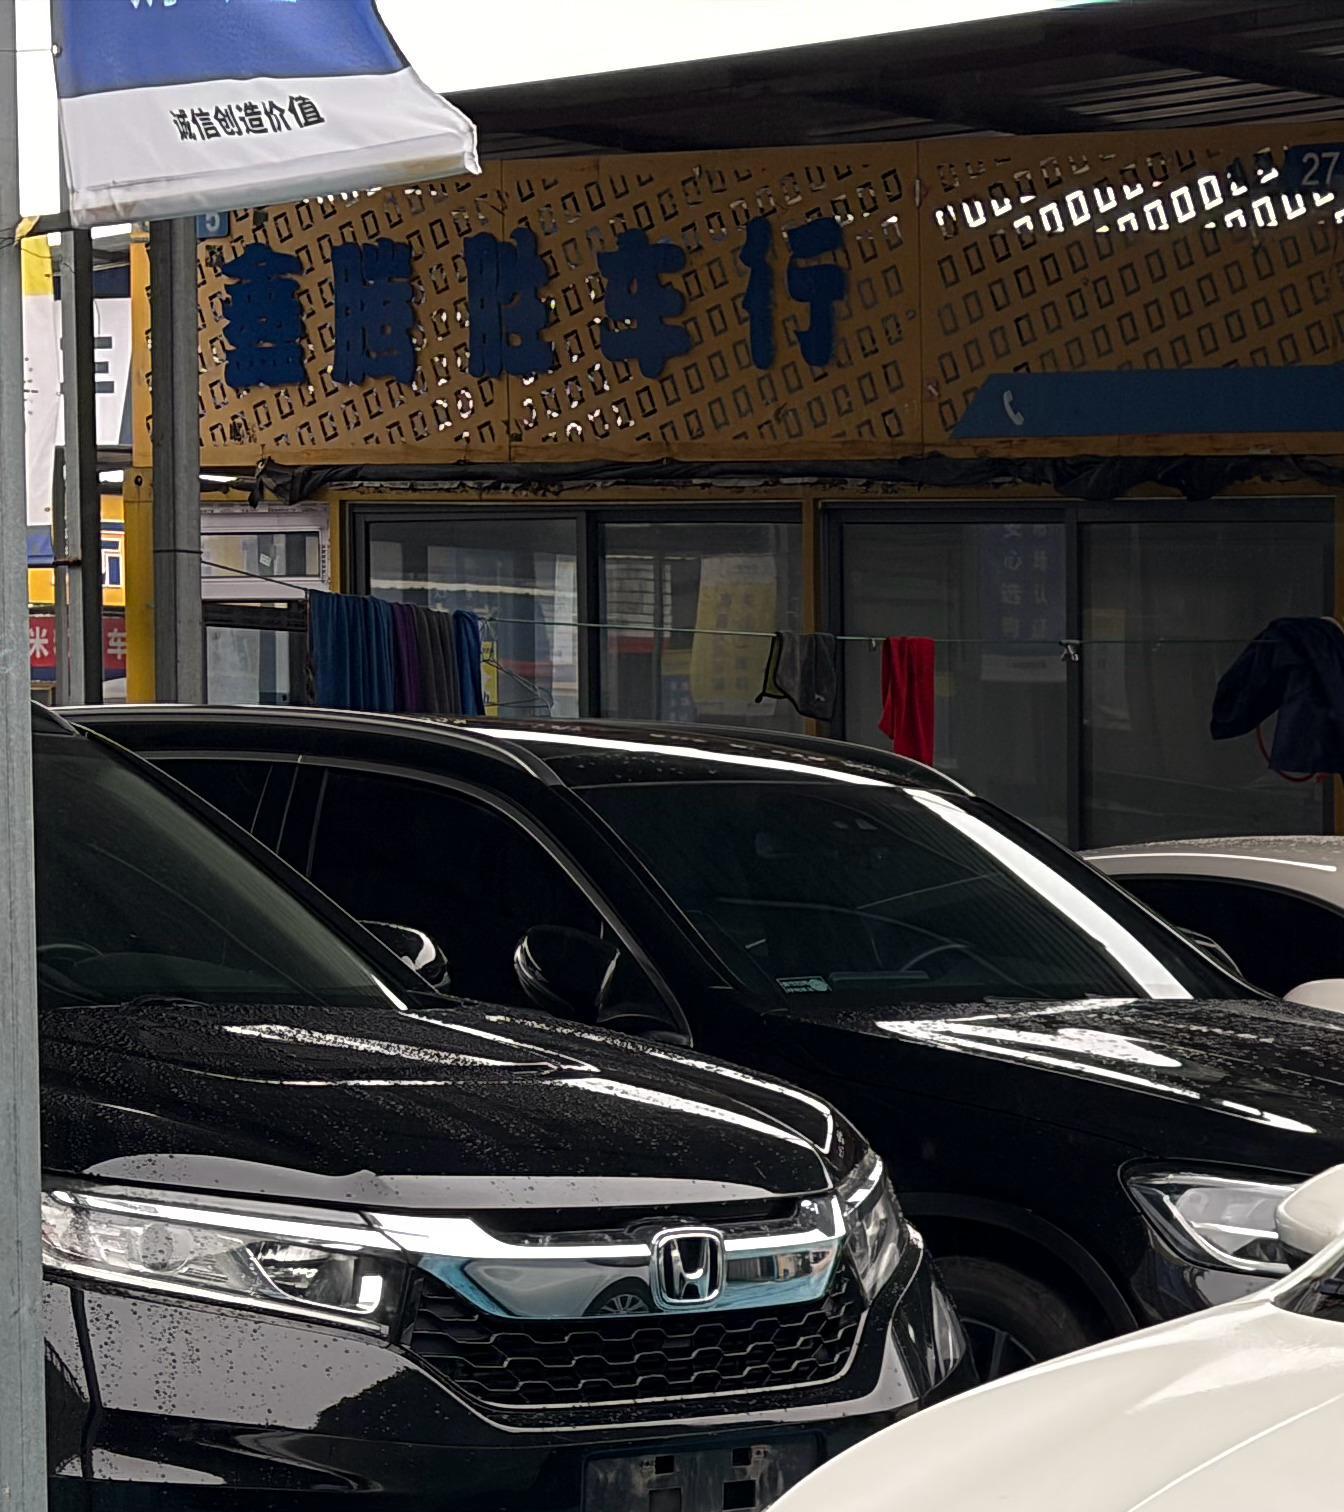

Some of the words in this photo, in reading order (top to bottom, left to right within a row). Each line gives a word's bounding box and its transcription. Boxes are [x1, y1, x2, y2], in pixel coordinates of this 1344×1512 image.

[170, 95, 325, 141] 诚信创造价值
[1301, 151, 1341, 187] 27
